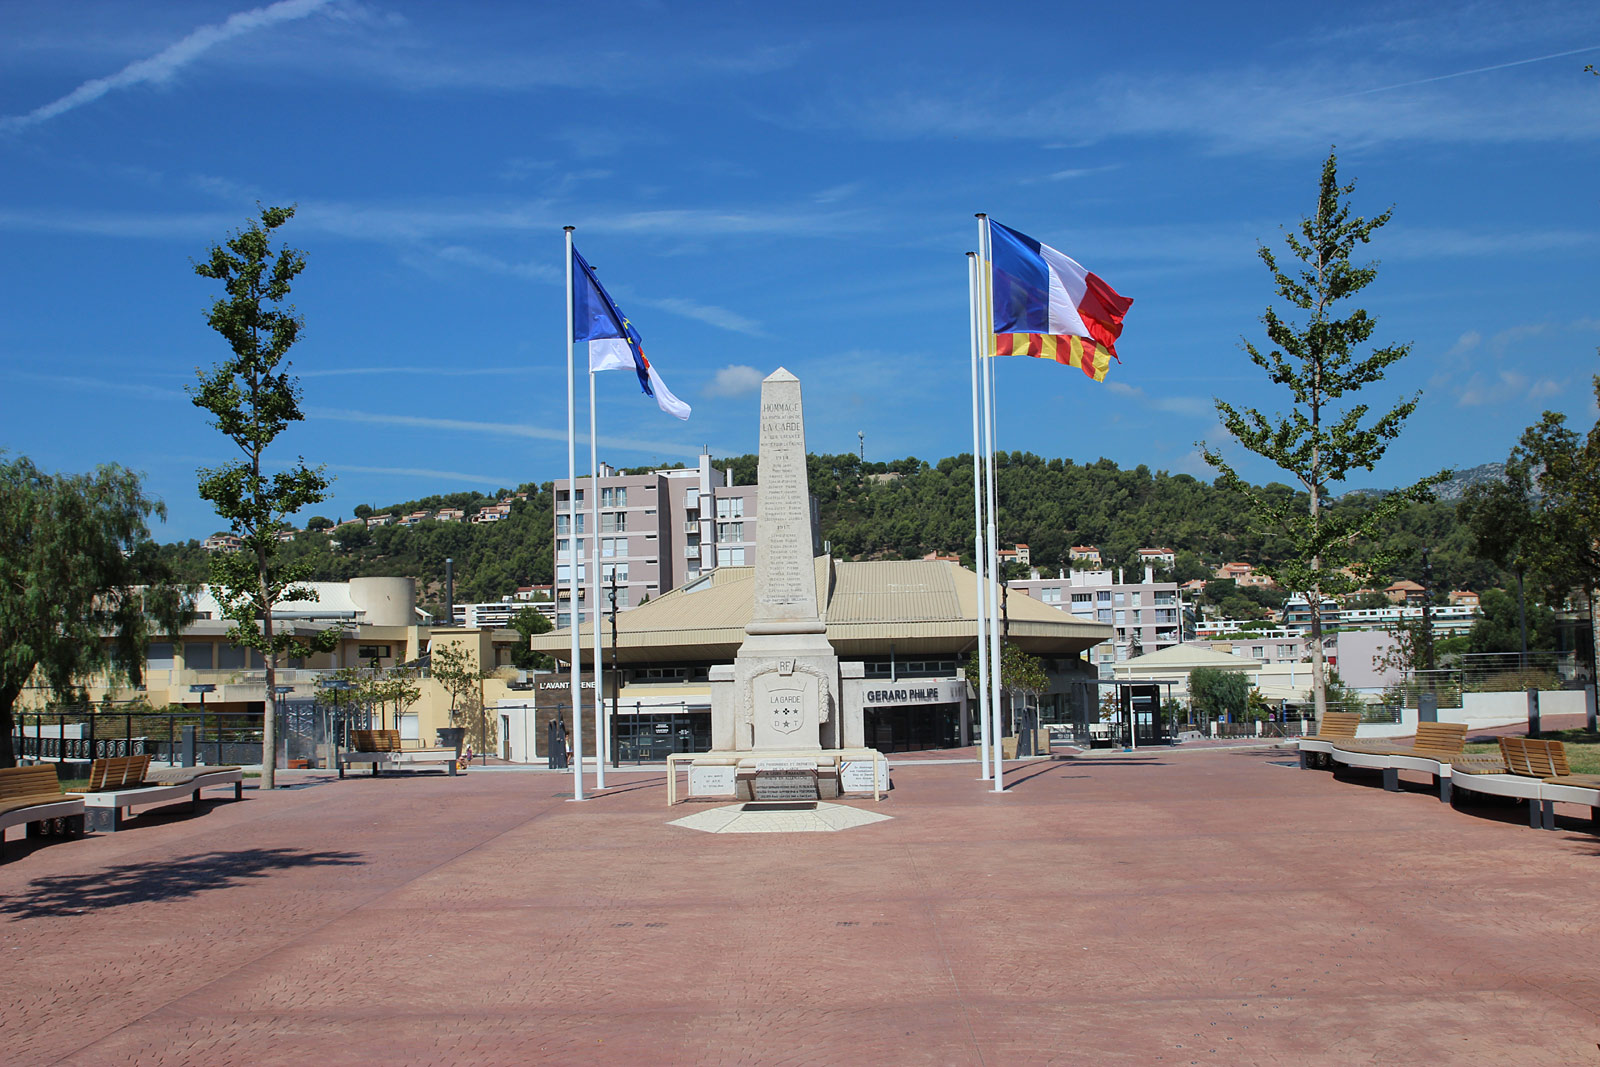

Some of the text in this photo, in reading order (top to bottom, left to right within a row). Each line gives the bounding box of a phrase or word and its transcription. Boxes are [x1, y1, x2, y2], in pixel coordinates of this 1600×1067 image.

[763, 403, 799, 412] HOMMAGE
[762, 422, 801, 432] LA GARDE
[540, 681, 570, 690] L'AVANT
[867, 689, 907, 701] GERARD
[909, 687, 938, 699] PHILIPE
[780, 695, 801, 704] GARDE
